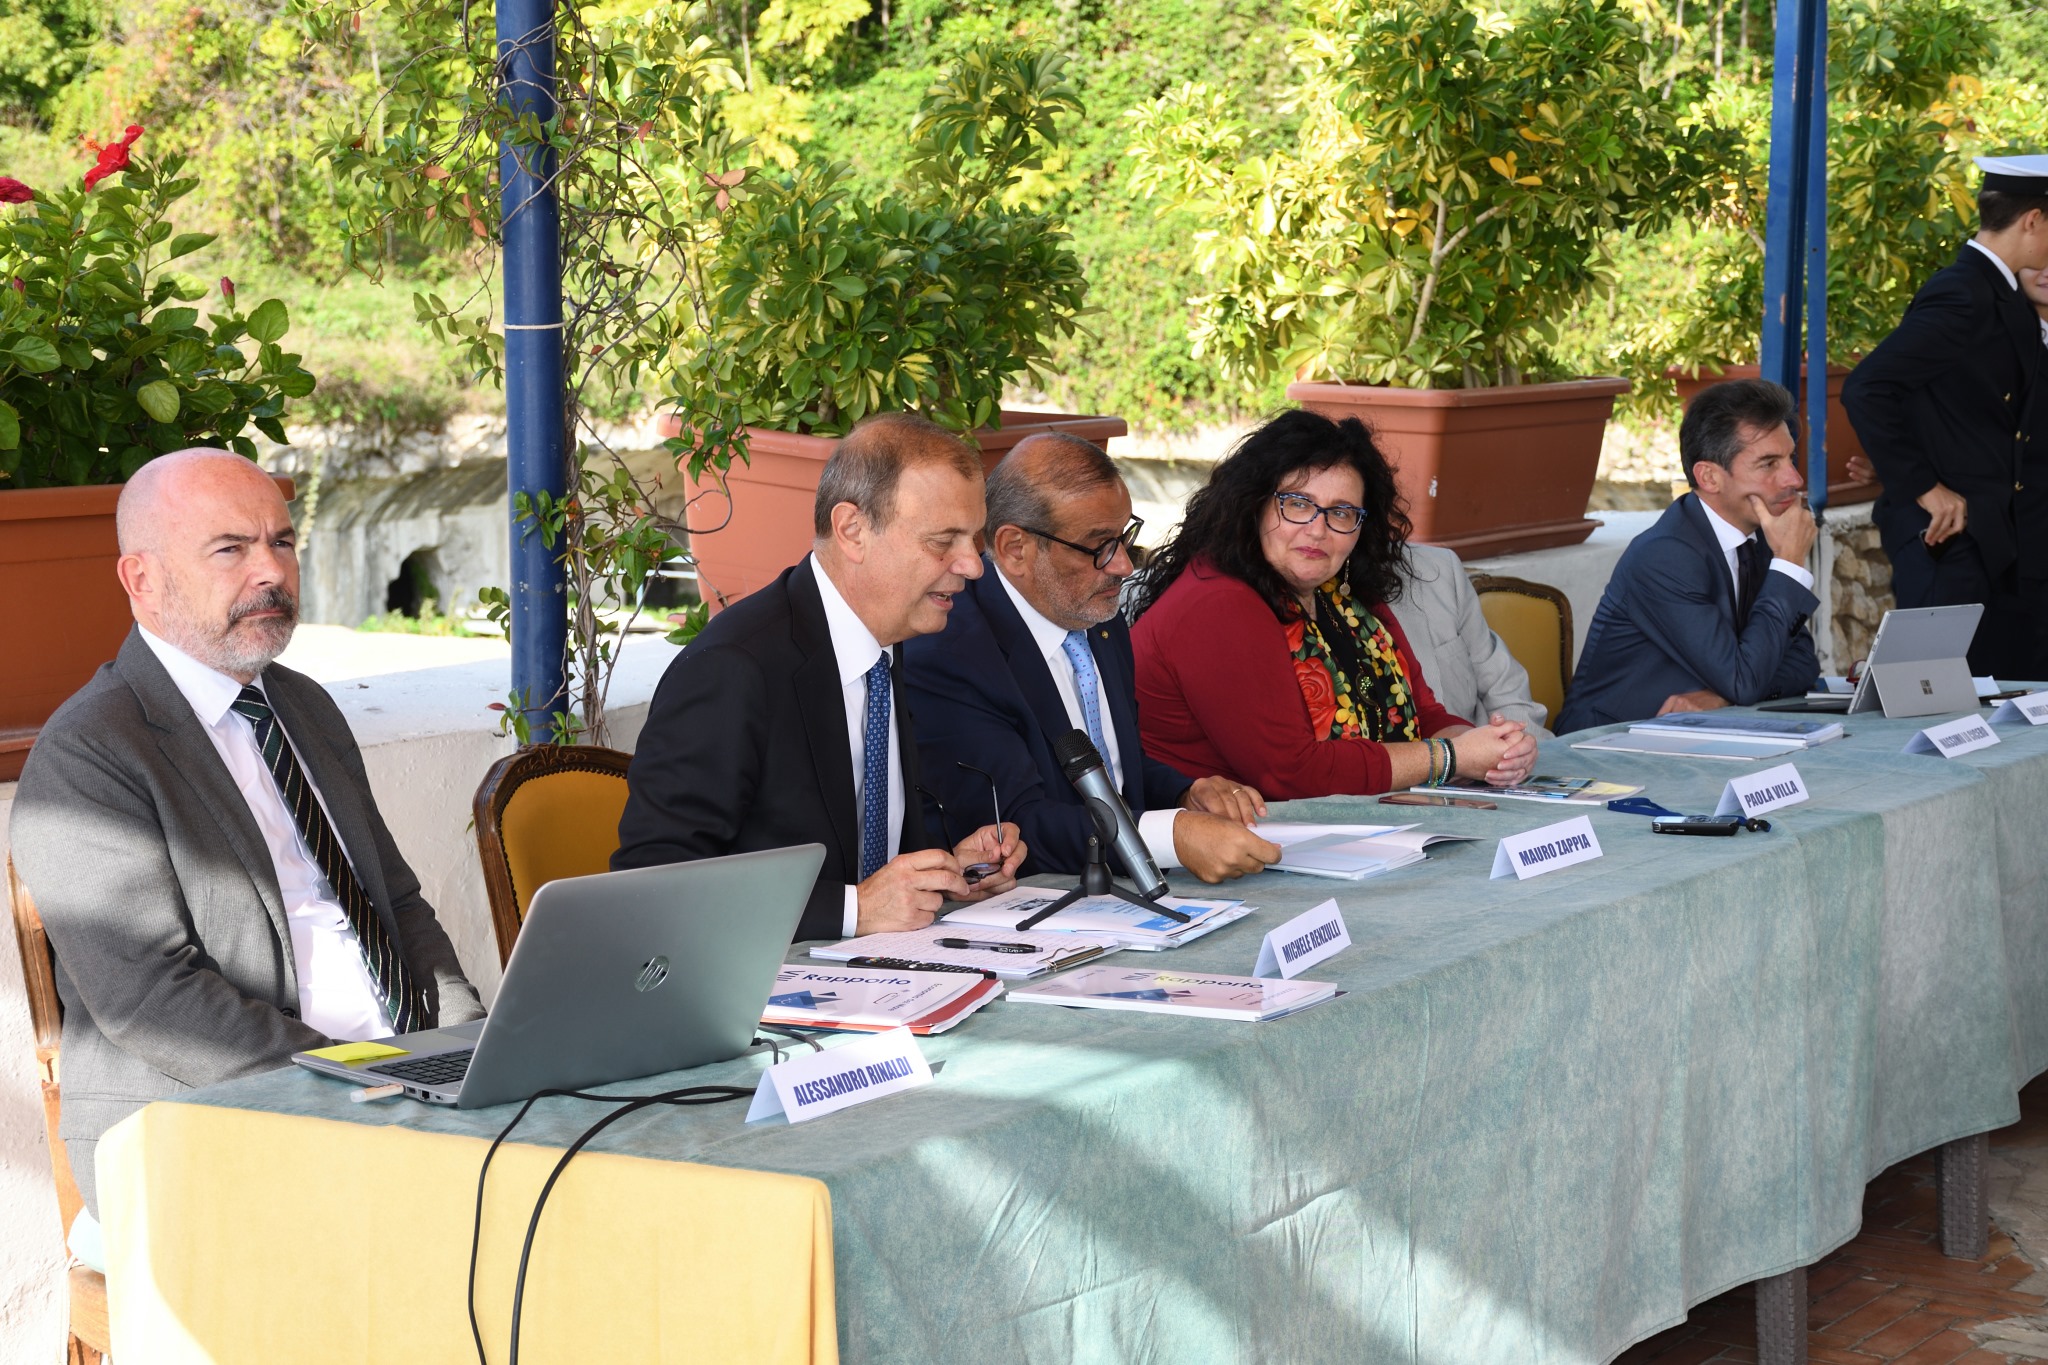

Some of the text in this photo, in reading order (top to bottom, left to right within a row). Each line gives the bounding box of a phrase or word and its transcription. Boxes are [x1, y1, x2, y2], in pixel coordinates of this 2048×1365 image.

[1743, 780, 1800, 809] PAOLA VILLA
[1518, 833, 1592, 867] MAURO ZAPPIA
[1281, 919, 1342, 964] MICHELE RENZULLI
[802, 973, 911, 985] Rapporto
[1153, 975, 1264, 989] Rapporto
[793, 1055, 914, 1107] ALESSANDRO RINALDI
